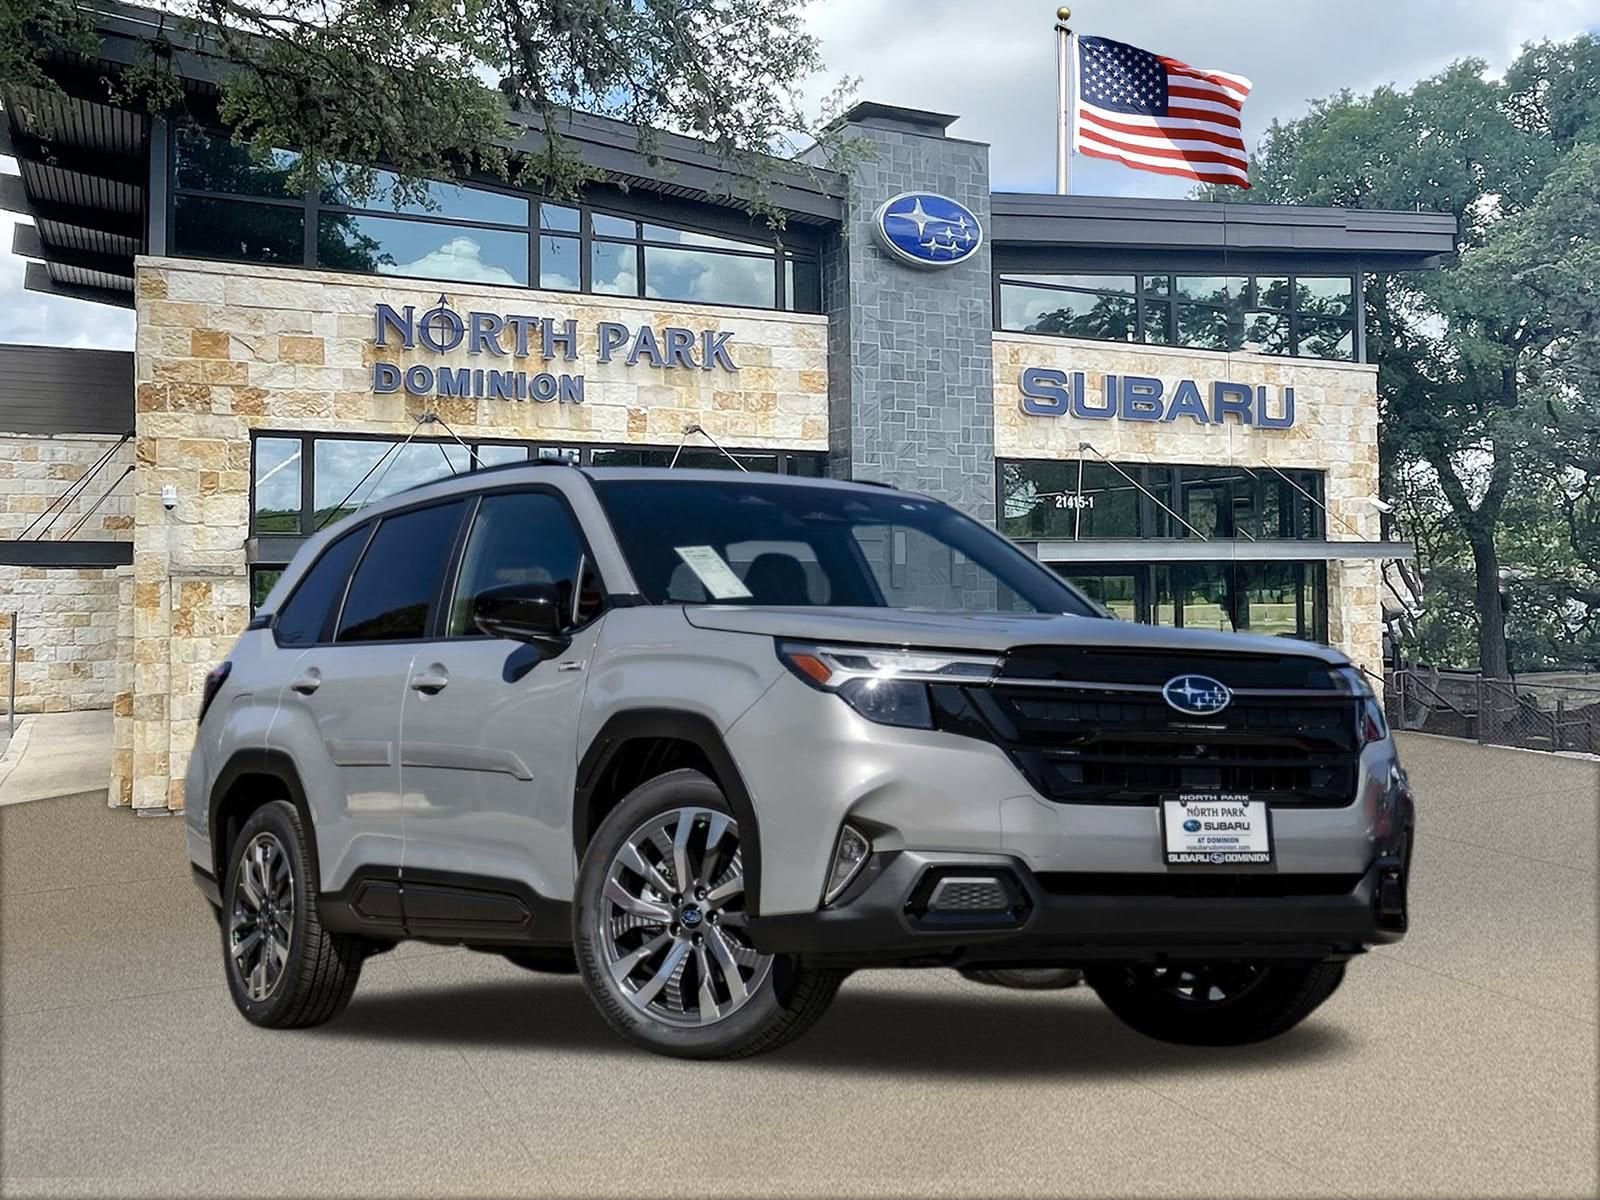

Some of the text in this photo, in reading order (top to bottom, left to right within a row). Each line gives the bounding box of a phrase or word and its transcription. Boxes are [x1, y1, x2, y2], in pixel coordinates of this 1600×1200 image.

[374, 293, 741, 373] NORTH PARK
[373, 362, 586, 405] DOMINION
[1019, 367, 1295, 430] SUBARU
[1055, 495, 1094, 509] 21415-1
[1186, 805, 1247, 817] NORTH PARK
[1204, 821, 1250, 831] SUBARU
[1168, 853, 1270, 863] SUBARU DOMINION
